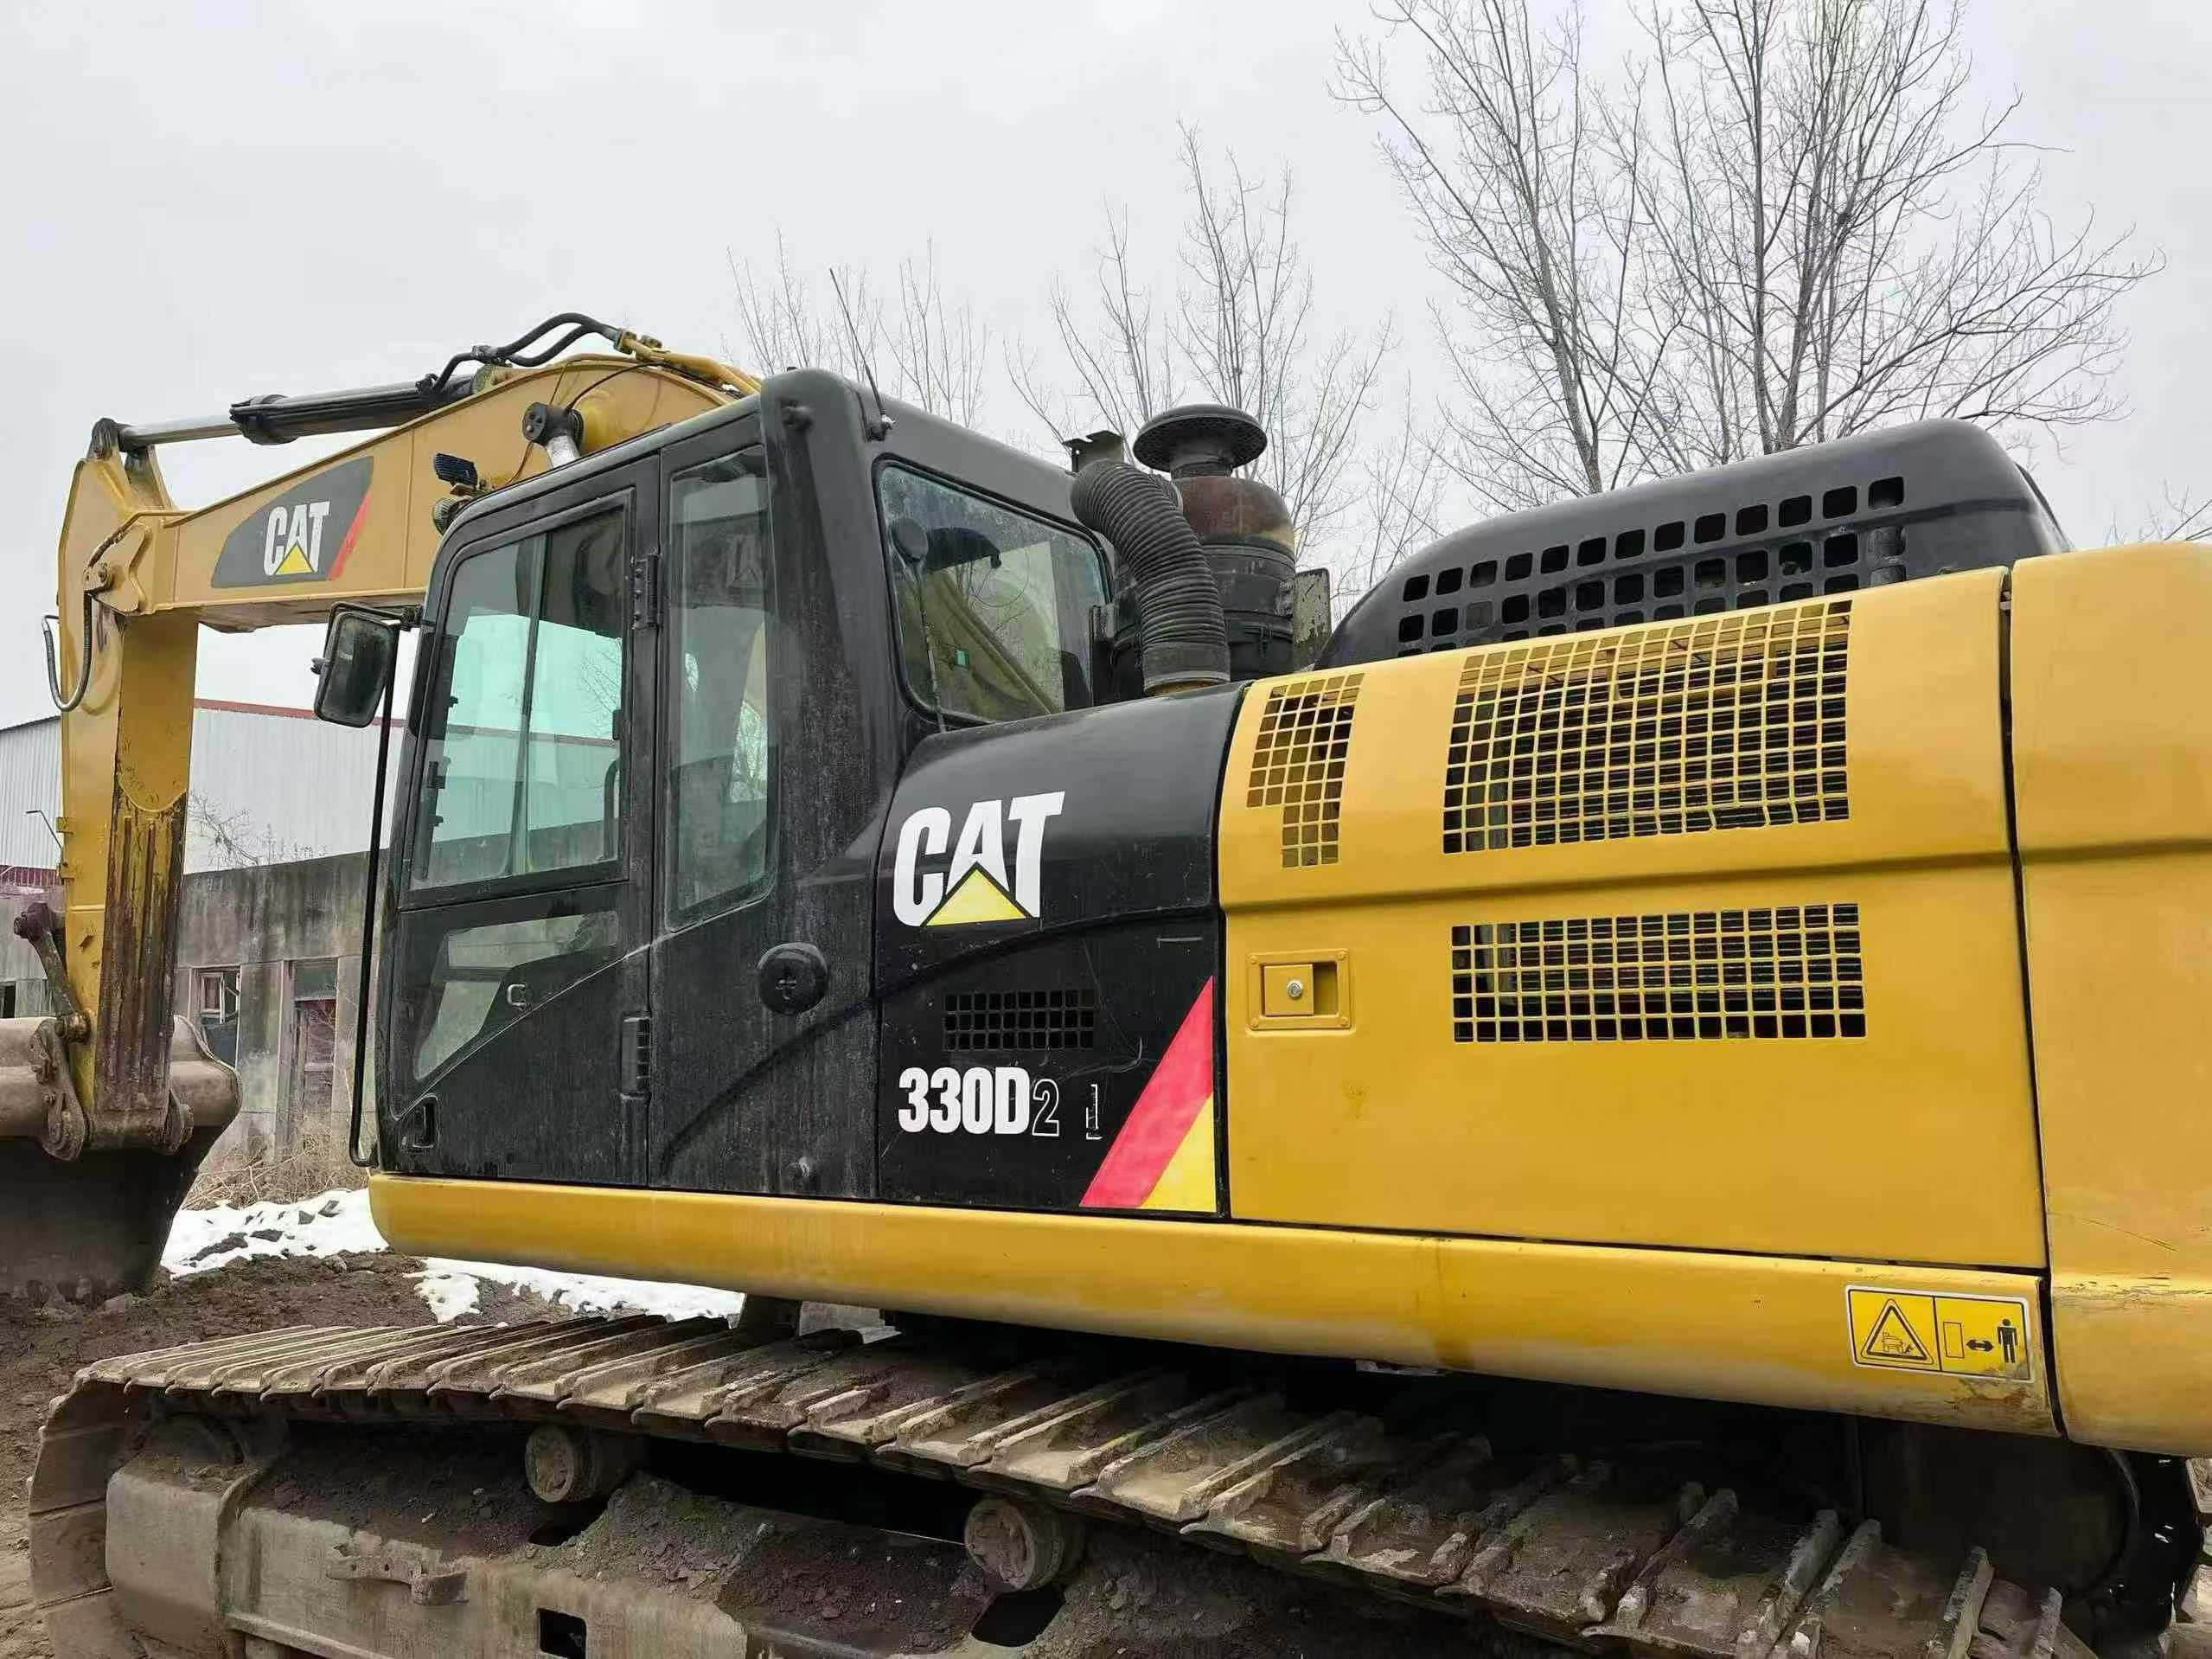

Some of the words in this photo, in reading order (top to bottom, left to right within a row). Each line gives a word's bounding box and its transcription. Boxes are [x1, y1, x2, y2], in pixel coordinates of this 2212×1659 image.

[263, 500, 331, 576] CAT
[893, 791, 1066, 926] CAT
[898, 1066, 1059, 1137] 330D2
